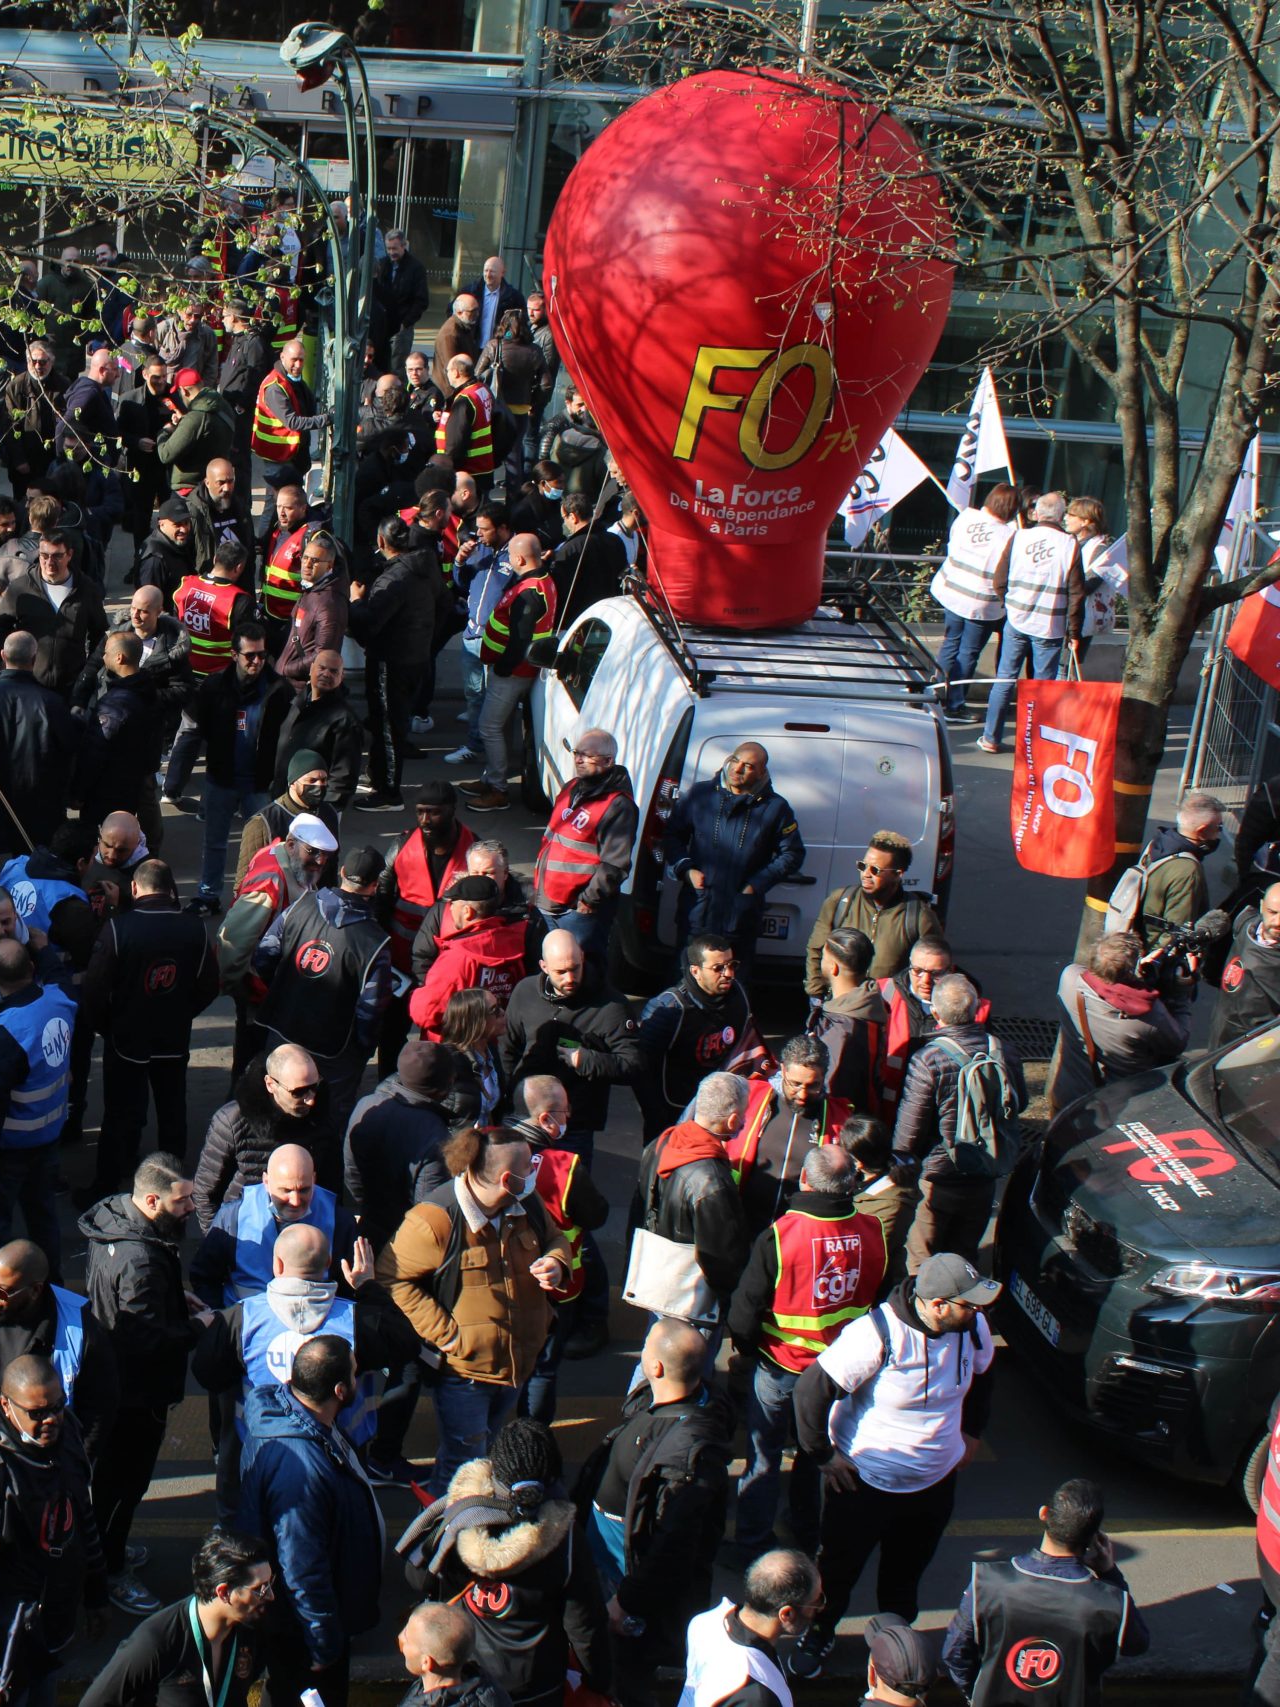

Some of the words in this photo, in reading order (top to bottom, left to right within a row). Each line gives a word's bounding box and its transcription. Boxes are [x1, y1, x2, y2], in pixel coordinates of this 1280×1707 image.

[321, 90, 432, 116] RATP
[673, 343, 835, 471] FO
[817, 424, 860, 462] 75
[696, 479, 725, 503] La
[731, 484, 802, 506] Force
[670, 492, 689, 509] De
[694, 499, 816, 523] l'indépendance
[709, 521, 720, 534] à
[725, 522, 768, 536] Paris
[967, 523, 988, 534] CFE
[1025, 539, 1048, 556] CFE
[194, 591, 217, 603] RATP
[184, 611, 210, 632] cgt
[1025, 701, 1036, 772] Transports
[1028, 774, 1036, 786] et
[1039, 724, 1099, 818] FO
[571, 811, 590, 830] FO
[1014, 789, 1036, 852] logistique
[305, 947, 330, 974] FO
[153, 964, 177, 990] FO
[1102, 1128, 1238, 1182] FO
[825, 1238, 860, 1253] RATP
[814, 1268, 860, 1303] cgt
[1020, 1649, 1059, 1680] FO
